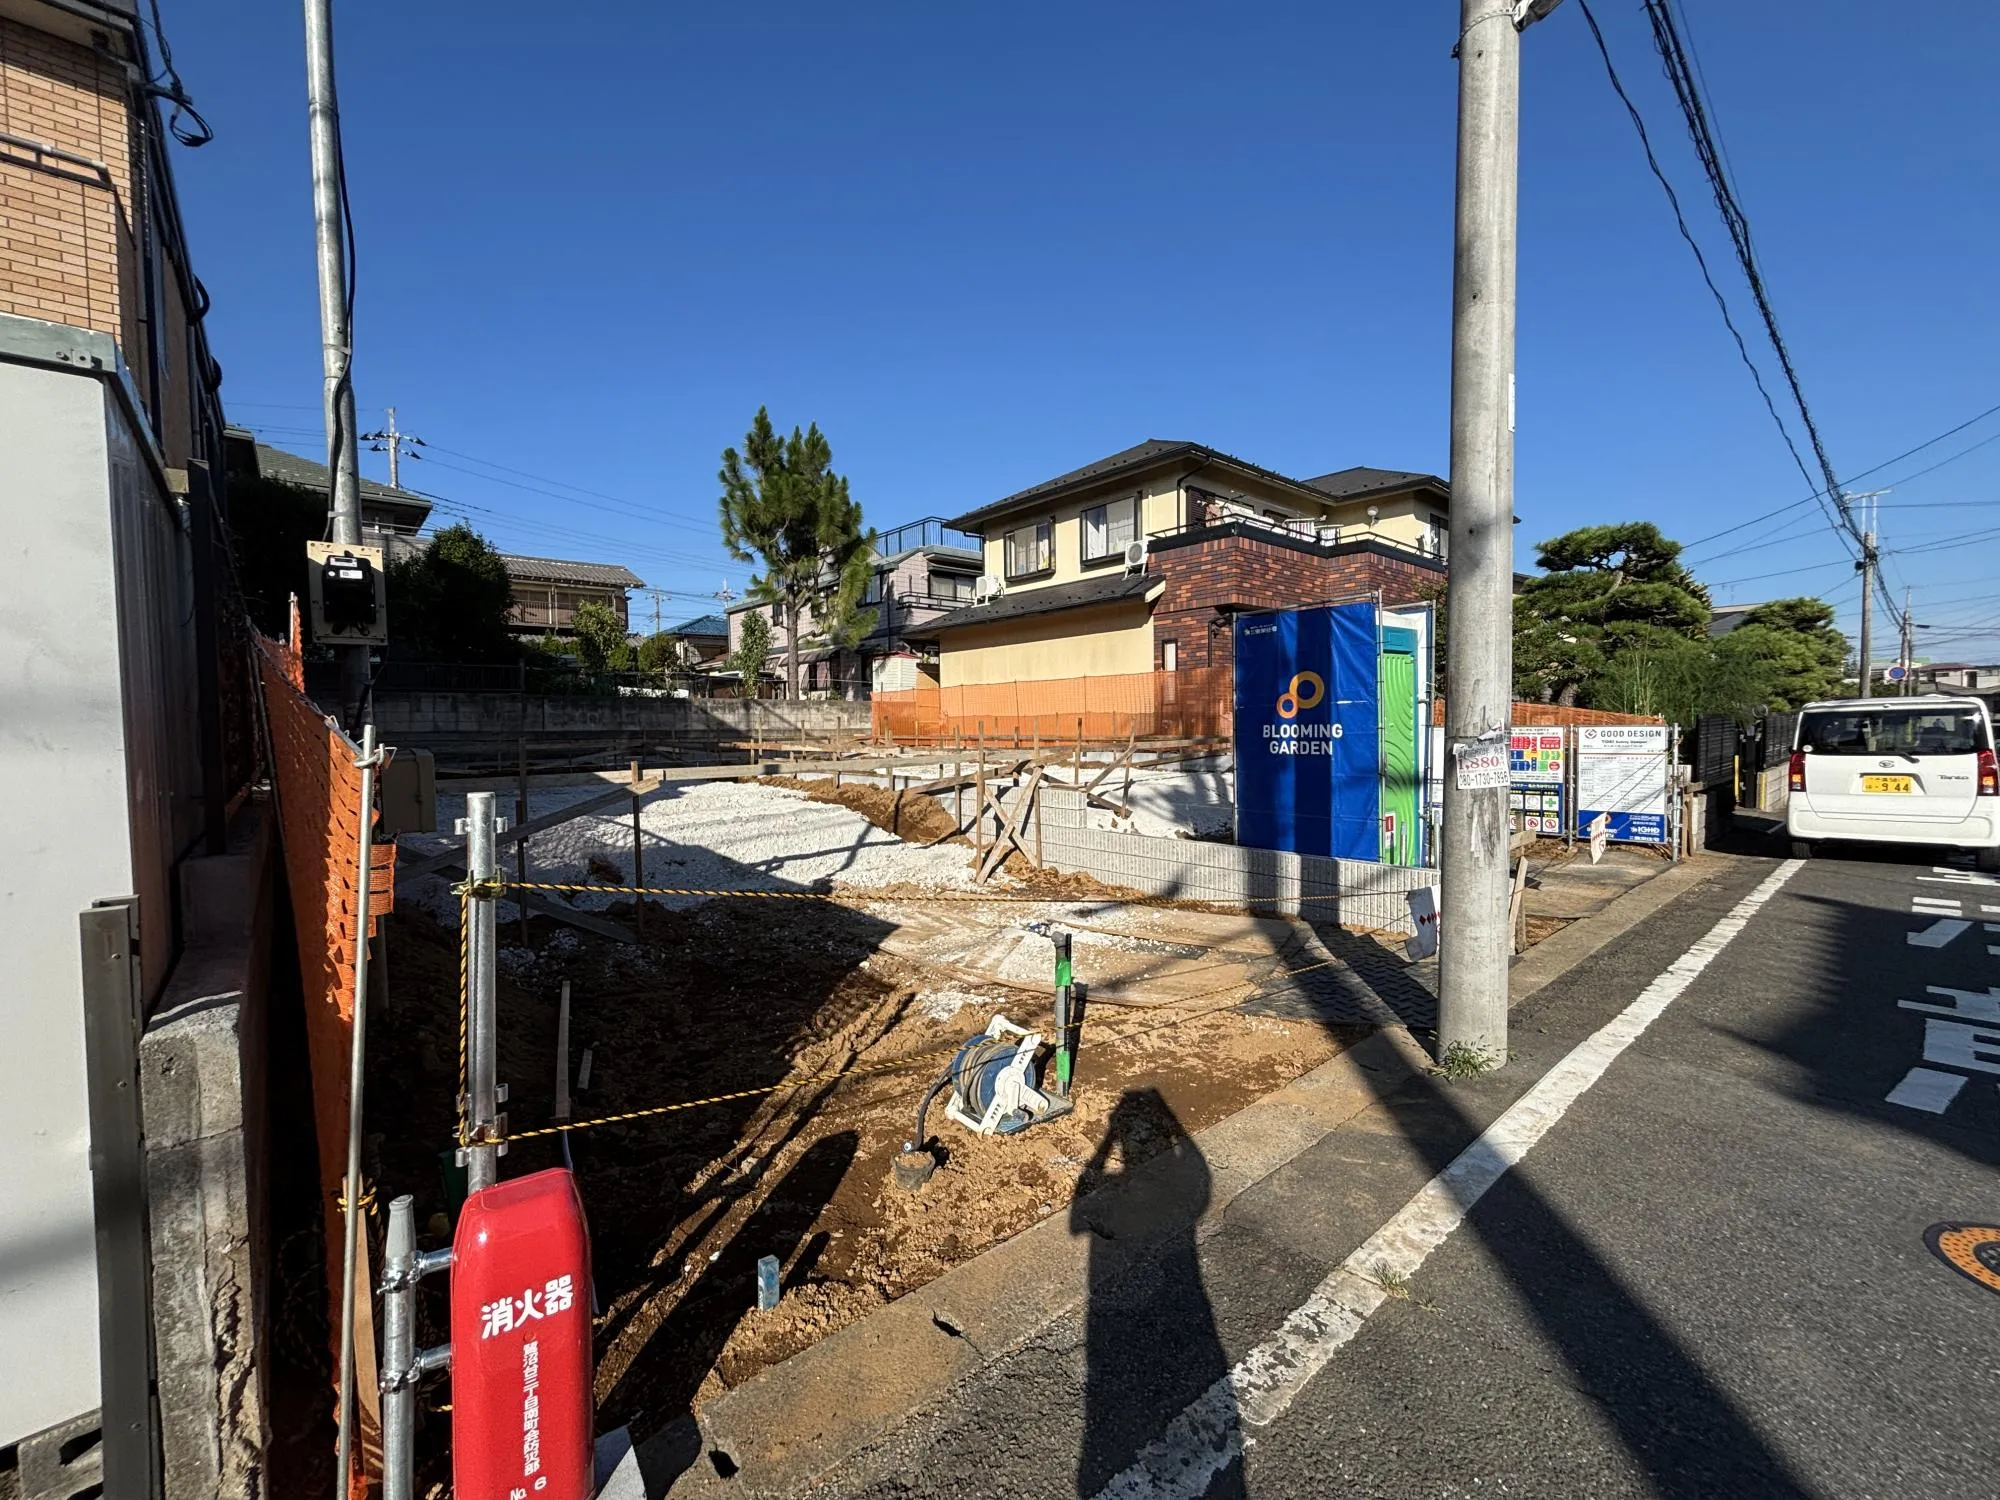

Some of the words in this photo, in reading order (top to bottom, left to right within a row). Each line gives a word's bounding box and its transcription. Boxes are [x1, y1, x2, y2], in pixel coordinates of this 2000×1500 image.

[1262, 724, 1343, 738] BLOOMING
[1600, 730, 1625, 738] GOOD
[1627, 730, 1662, 738] DESIGN
[1269, 740, 1333, 755] GARDEN
[1458, 756, 1499, 769] 1,880
[481, 1274, 574, 1339] 消火器
[534, 1476, 547, 1490] 6
